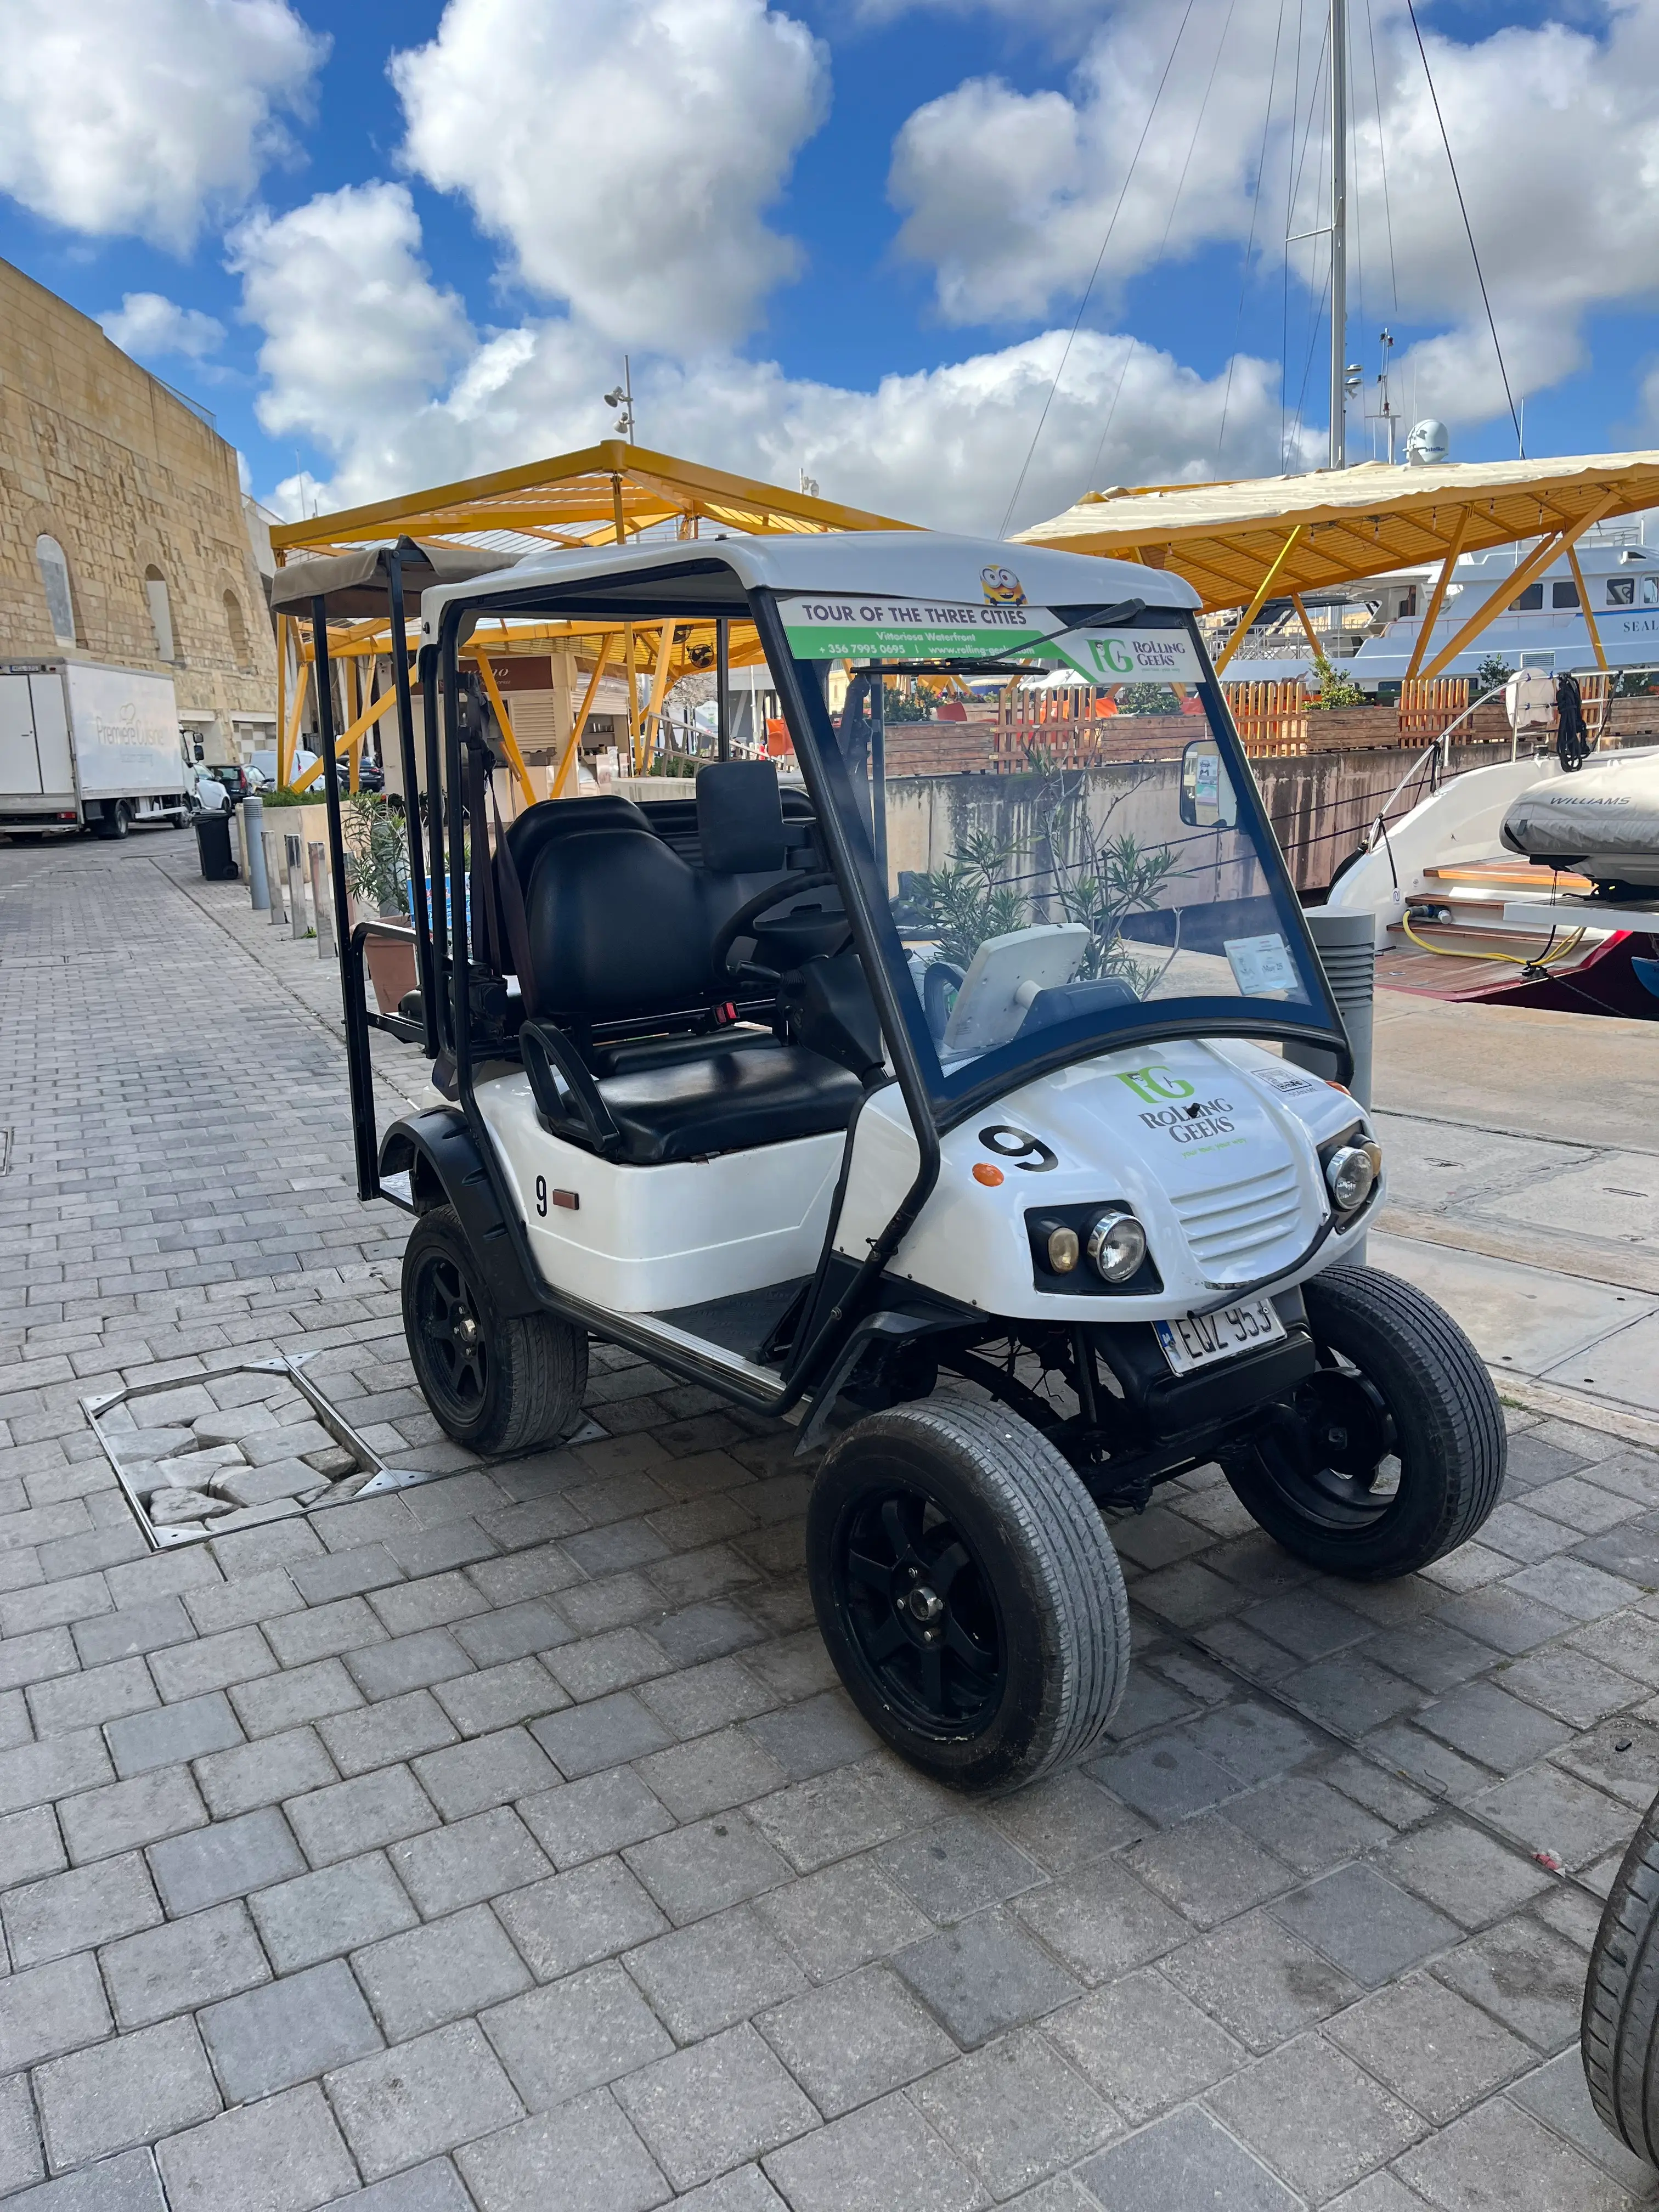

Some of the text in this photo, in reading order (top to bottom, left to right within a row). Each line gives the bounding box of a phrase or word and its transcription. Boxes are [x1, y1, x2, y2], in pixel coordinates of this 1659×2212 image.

[802, 605, 1027, 625] TOUR OF THE THREE CITIES
[876, 631, 976, 642] Vittoriosa Waterfront
[828, 644, 849, 653] 356
[850, 644, 877, 654] 7995
[879, 644, 906, 654] 0695
[1132, 640, 1186, 653] ROLLING
[1137, 653, 1175, 666] GEEKS
[1550, 797, 1632, 805] WILLIAMS
[1169, 1116, 1235, 1143] GEEKS
[978, 1125, 1059, 1172] 9
[536, 1175, 548, 1217] 9
